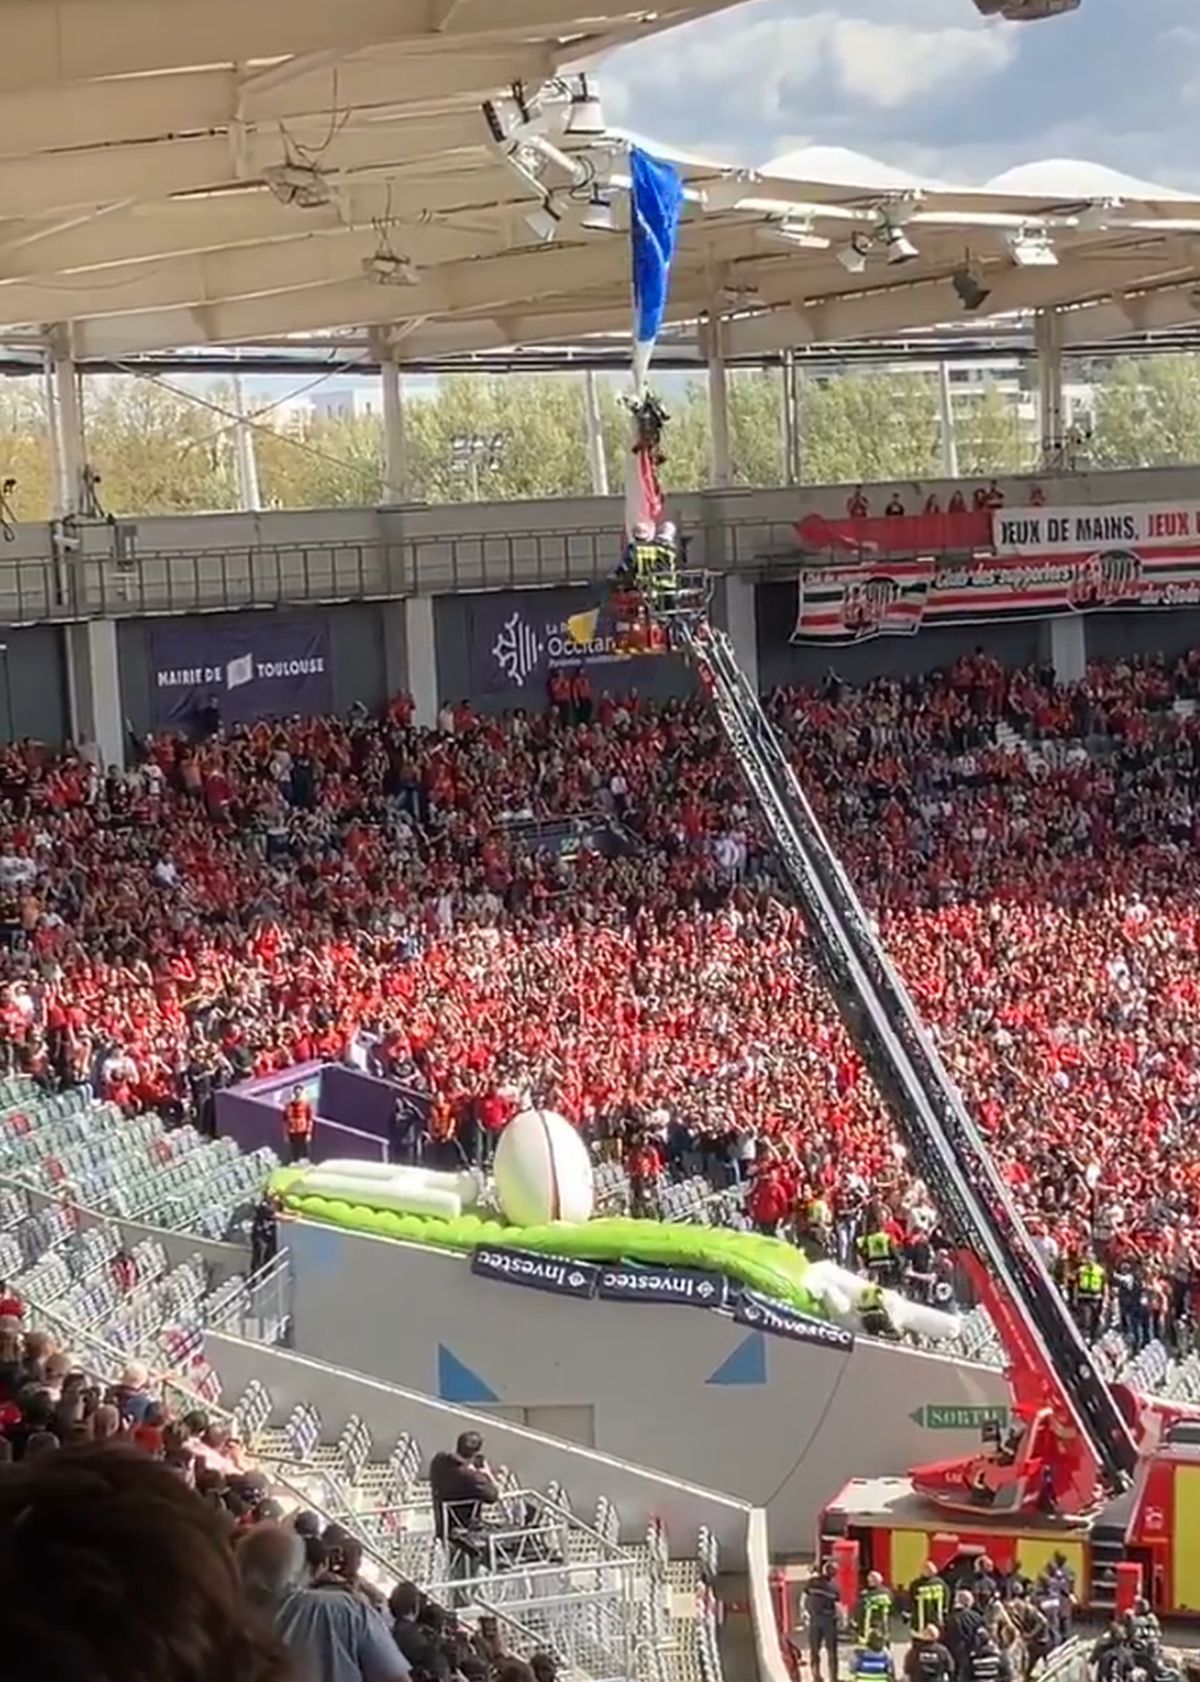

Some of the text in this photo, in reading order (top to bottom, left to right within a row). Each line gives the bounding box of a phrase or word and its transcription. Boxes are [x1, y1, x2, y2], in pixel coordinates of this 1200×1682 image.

[1001, 519, 1040, 545] JEUX
[1047, 518, 1070, 542] DE
[1075, 515, 1140, 541] MAINS,
[1147, 512, 1189, 537] JEUX
[158, 658, 324, 687] MAIRIE DE TOULOUSE
[478, 1250, 566, 1285] Investec
[603, 1273, 694, 1297] Investec
